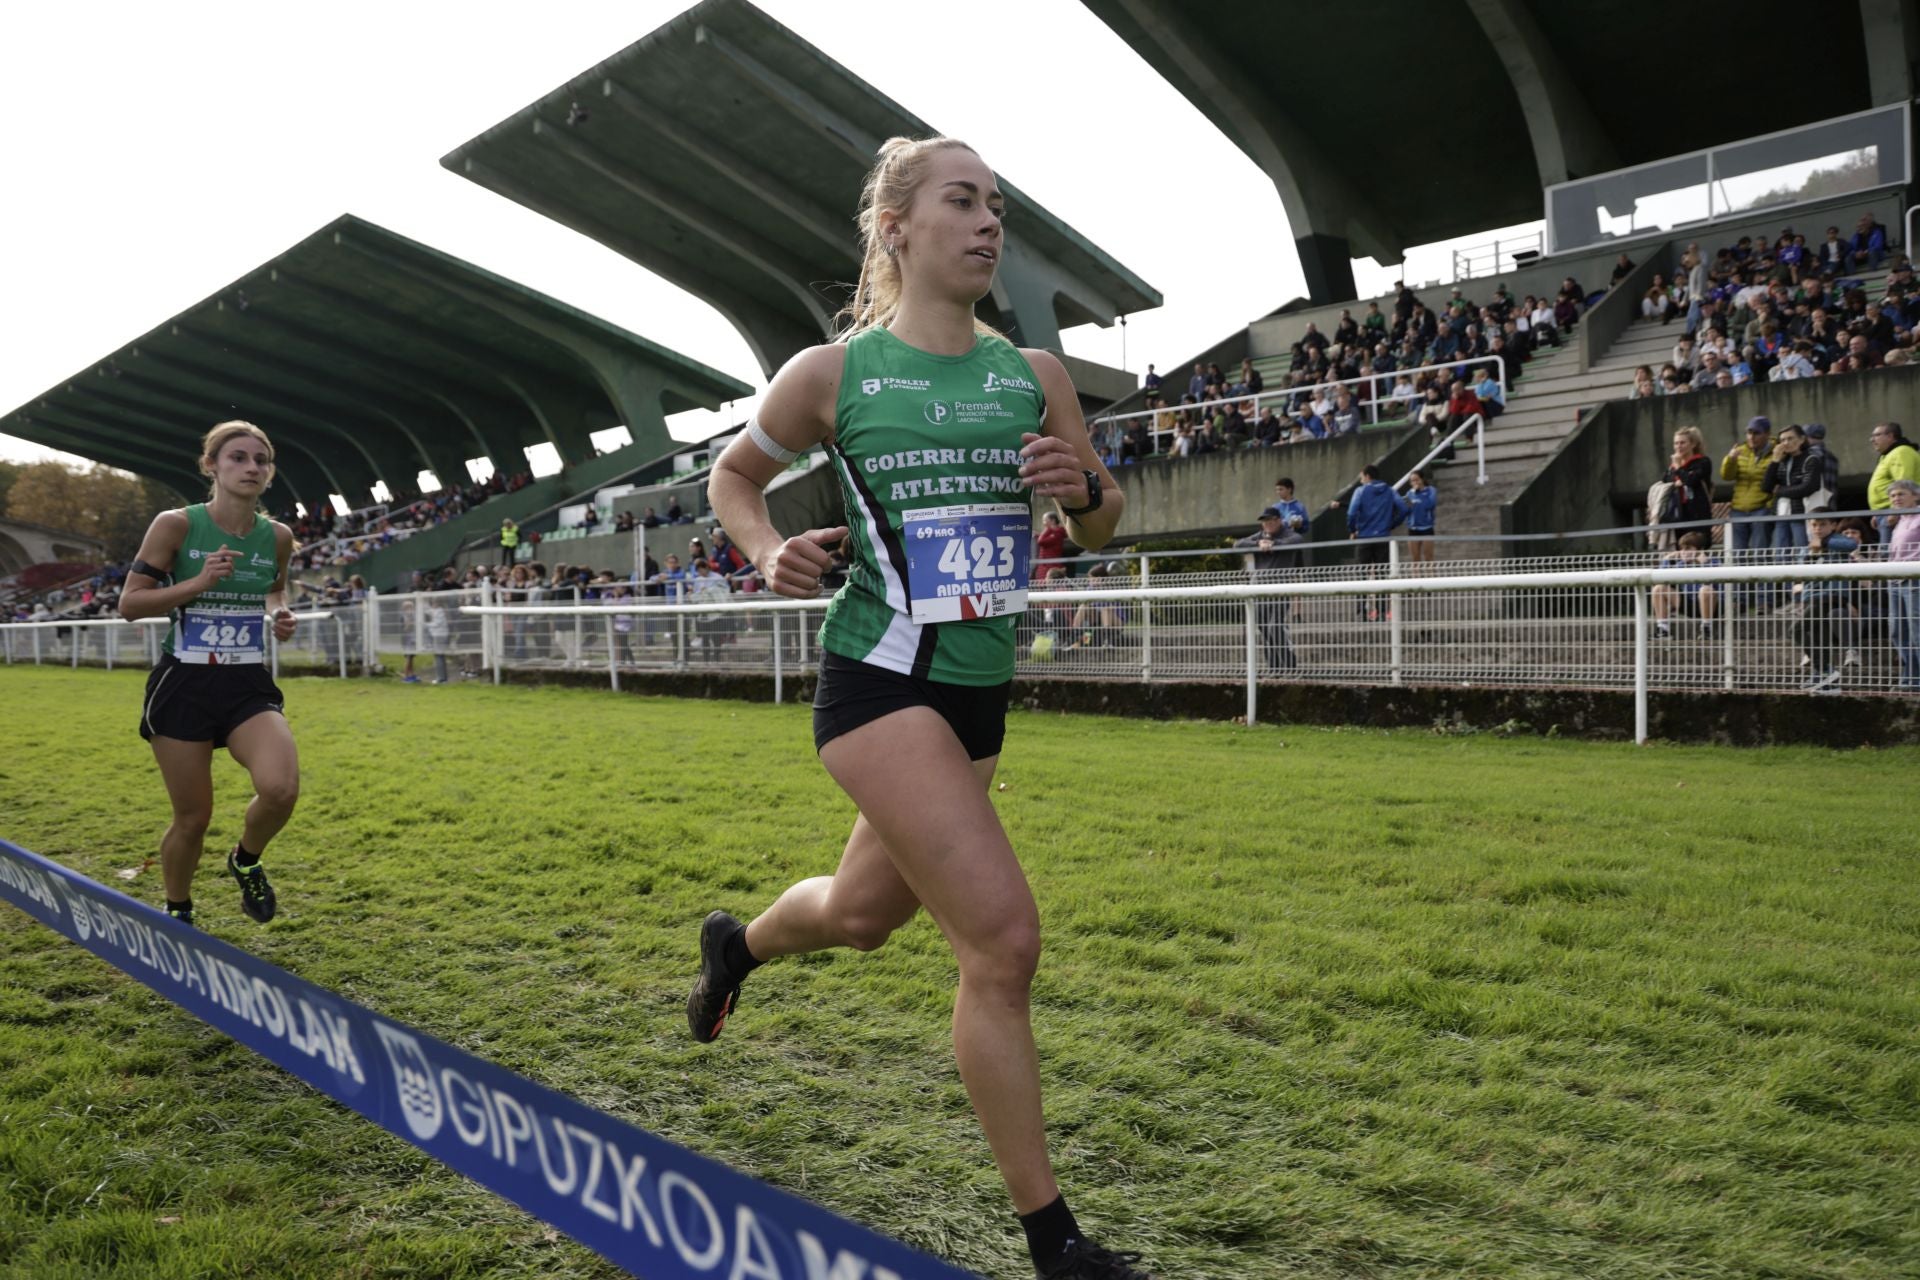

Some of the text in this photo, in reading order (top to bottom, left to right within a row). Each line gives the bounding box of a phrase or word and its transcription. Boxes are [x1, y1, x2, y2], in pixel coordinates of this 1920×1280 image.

[955, 401, 1002, 411] Premank
[865, 449, 965, 474] GOIERRI
[891, 476, 1025, 500] ATLETISMO
[917, 527, 933, 539] 69
[938, 536, 1015, 580] 423
[937, 579, 1016, 597] AIDA DELGADO
[200, 625, 251, 646] 426
[80, 894, 206, 997] GIPUZKOA
[198, 949, 366, 1085] KIROLAK
[441, 1068, 781, 1280] GIPUZKOA
